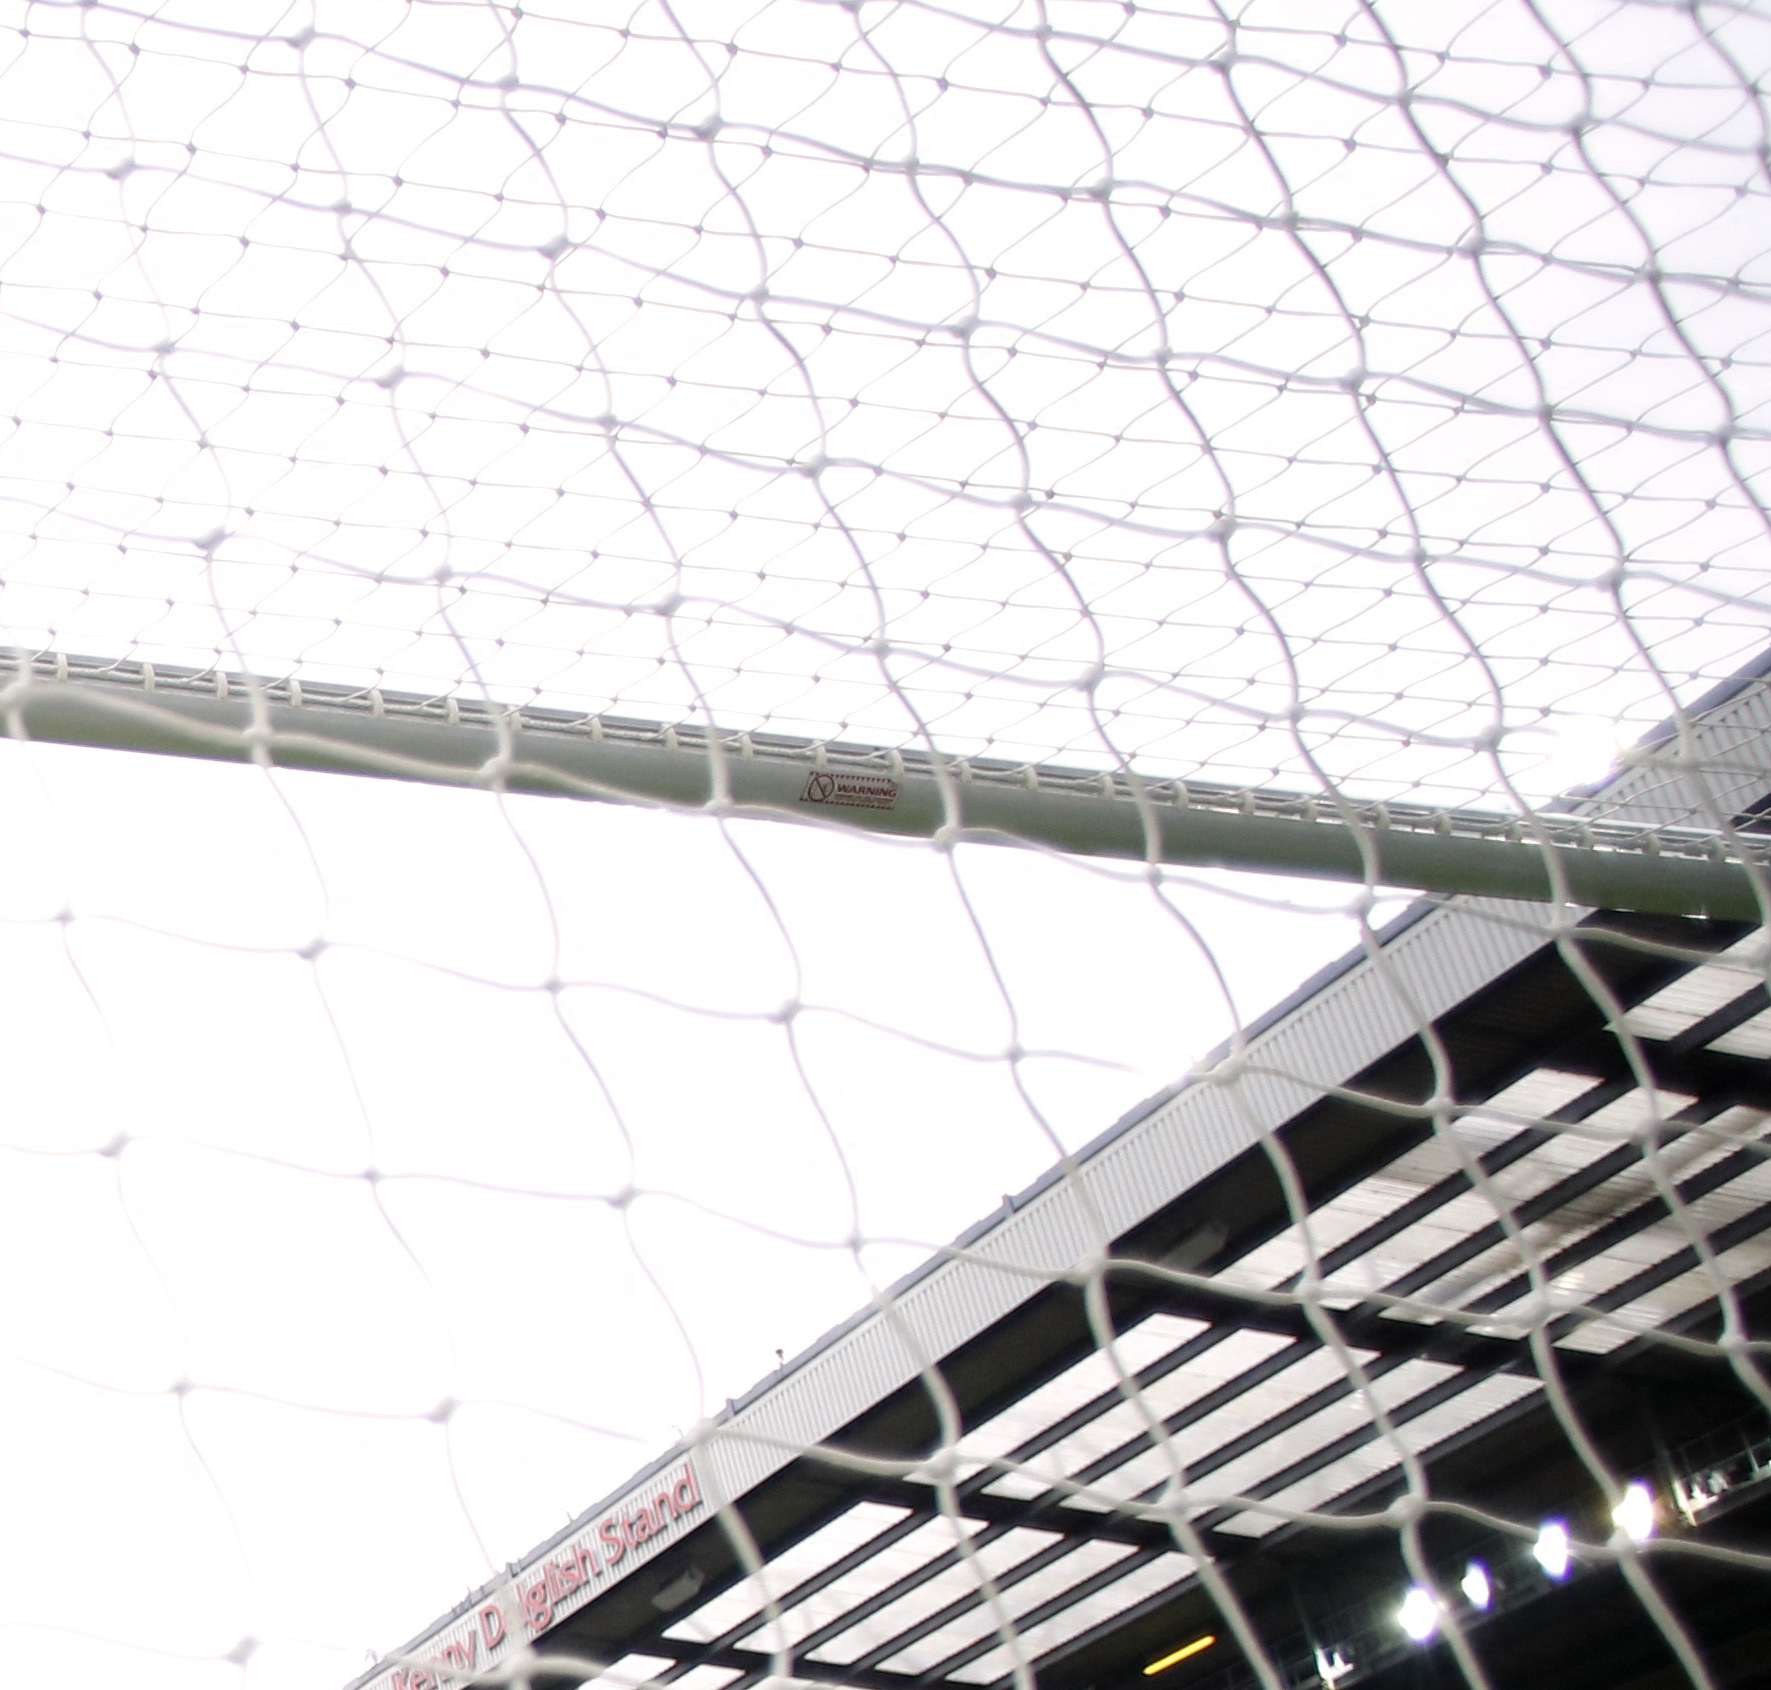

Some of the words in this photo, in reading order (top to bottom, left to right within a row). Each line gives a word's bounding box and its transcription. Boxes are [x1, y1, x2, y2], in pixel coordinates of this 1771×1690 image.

[837, 783, 897, 798] WARNING
[478, 1543, 603, 1650] Dlglish
[598, 1461, 702, 1567] Stand
